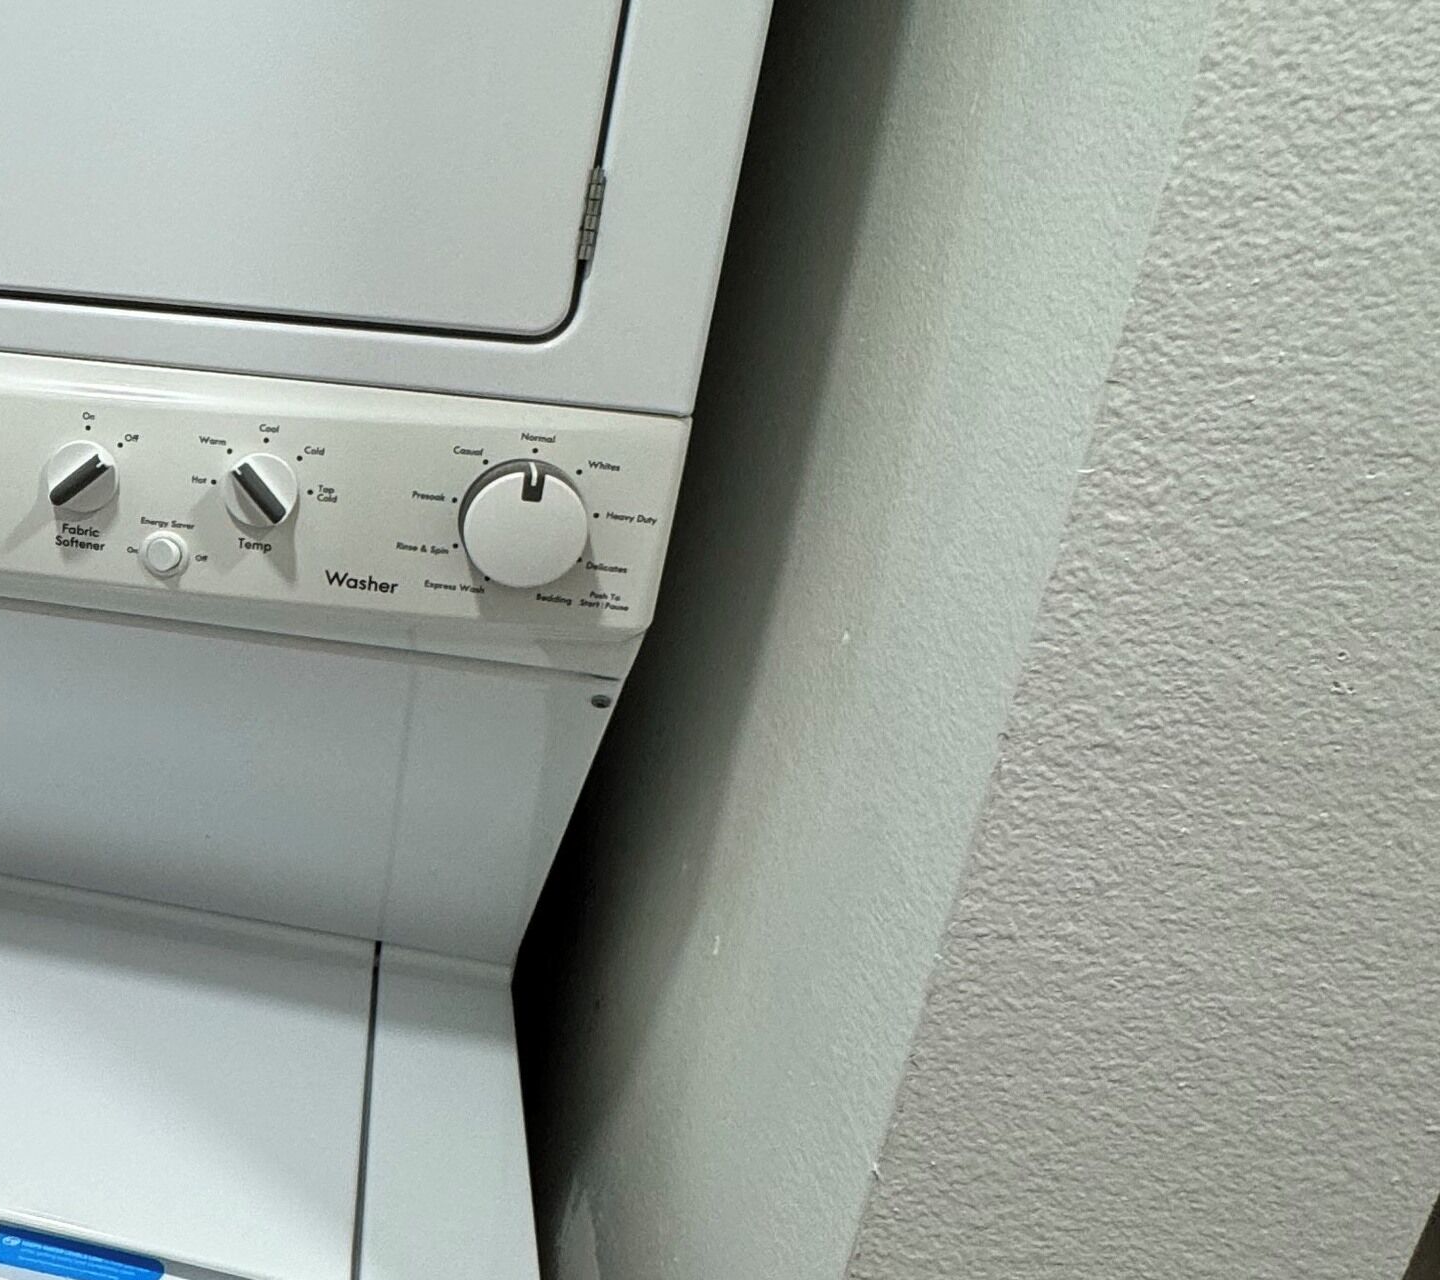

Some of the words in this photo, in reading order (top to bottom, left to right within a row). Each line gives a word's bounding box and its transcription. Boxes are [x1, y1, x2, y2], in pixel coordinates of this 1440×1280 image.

[82, 411, 95, 420] On
[259, 423, 280, 433] Cool
[124, 434, 139, 442] Off
[199, 436, 226, 446] Warm
[521, 433, 556, 443] Normal
[304, 446, 325, 456] Cold
[453, 445, 484, 456] Casual
[588, 460, 621, 472] Whites
[192, 475, 207, 484] Hot
[318, 485, 335, 495] Tap
[412, 490, 445, 501] Presoak
[317, 494, 338, 503] Cold
[140, 517, 169, 528] Energy
[171, 520, 195, 530] Saver
[606, 512, 634, 523] Heavy
[636, 515, 658, 525] Duty
[62, 523, 100, 538] Fabric
[55, 535, 105, 551] Softener
[238, 538, 272, 553] Temp
[396, 542, 418, 552] Rinse
[420, 544, 427, 552] &
[430, 546, 449, 555] Spin
[127, 546, 139, 554] On
[195, 554, 208, 562] Off
[586, 561, 627, 573] Delicates
[325, 570, 399, 594] Washer
[424, 579, 456, 592] Express
[460, 582, 485, 594] Wash
[536, 593, 572, 606] Bedding
[589, 591, 608, 600] Push
[610, 593, 621, 601] To
